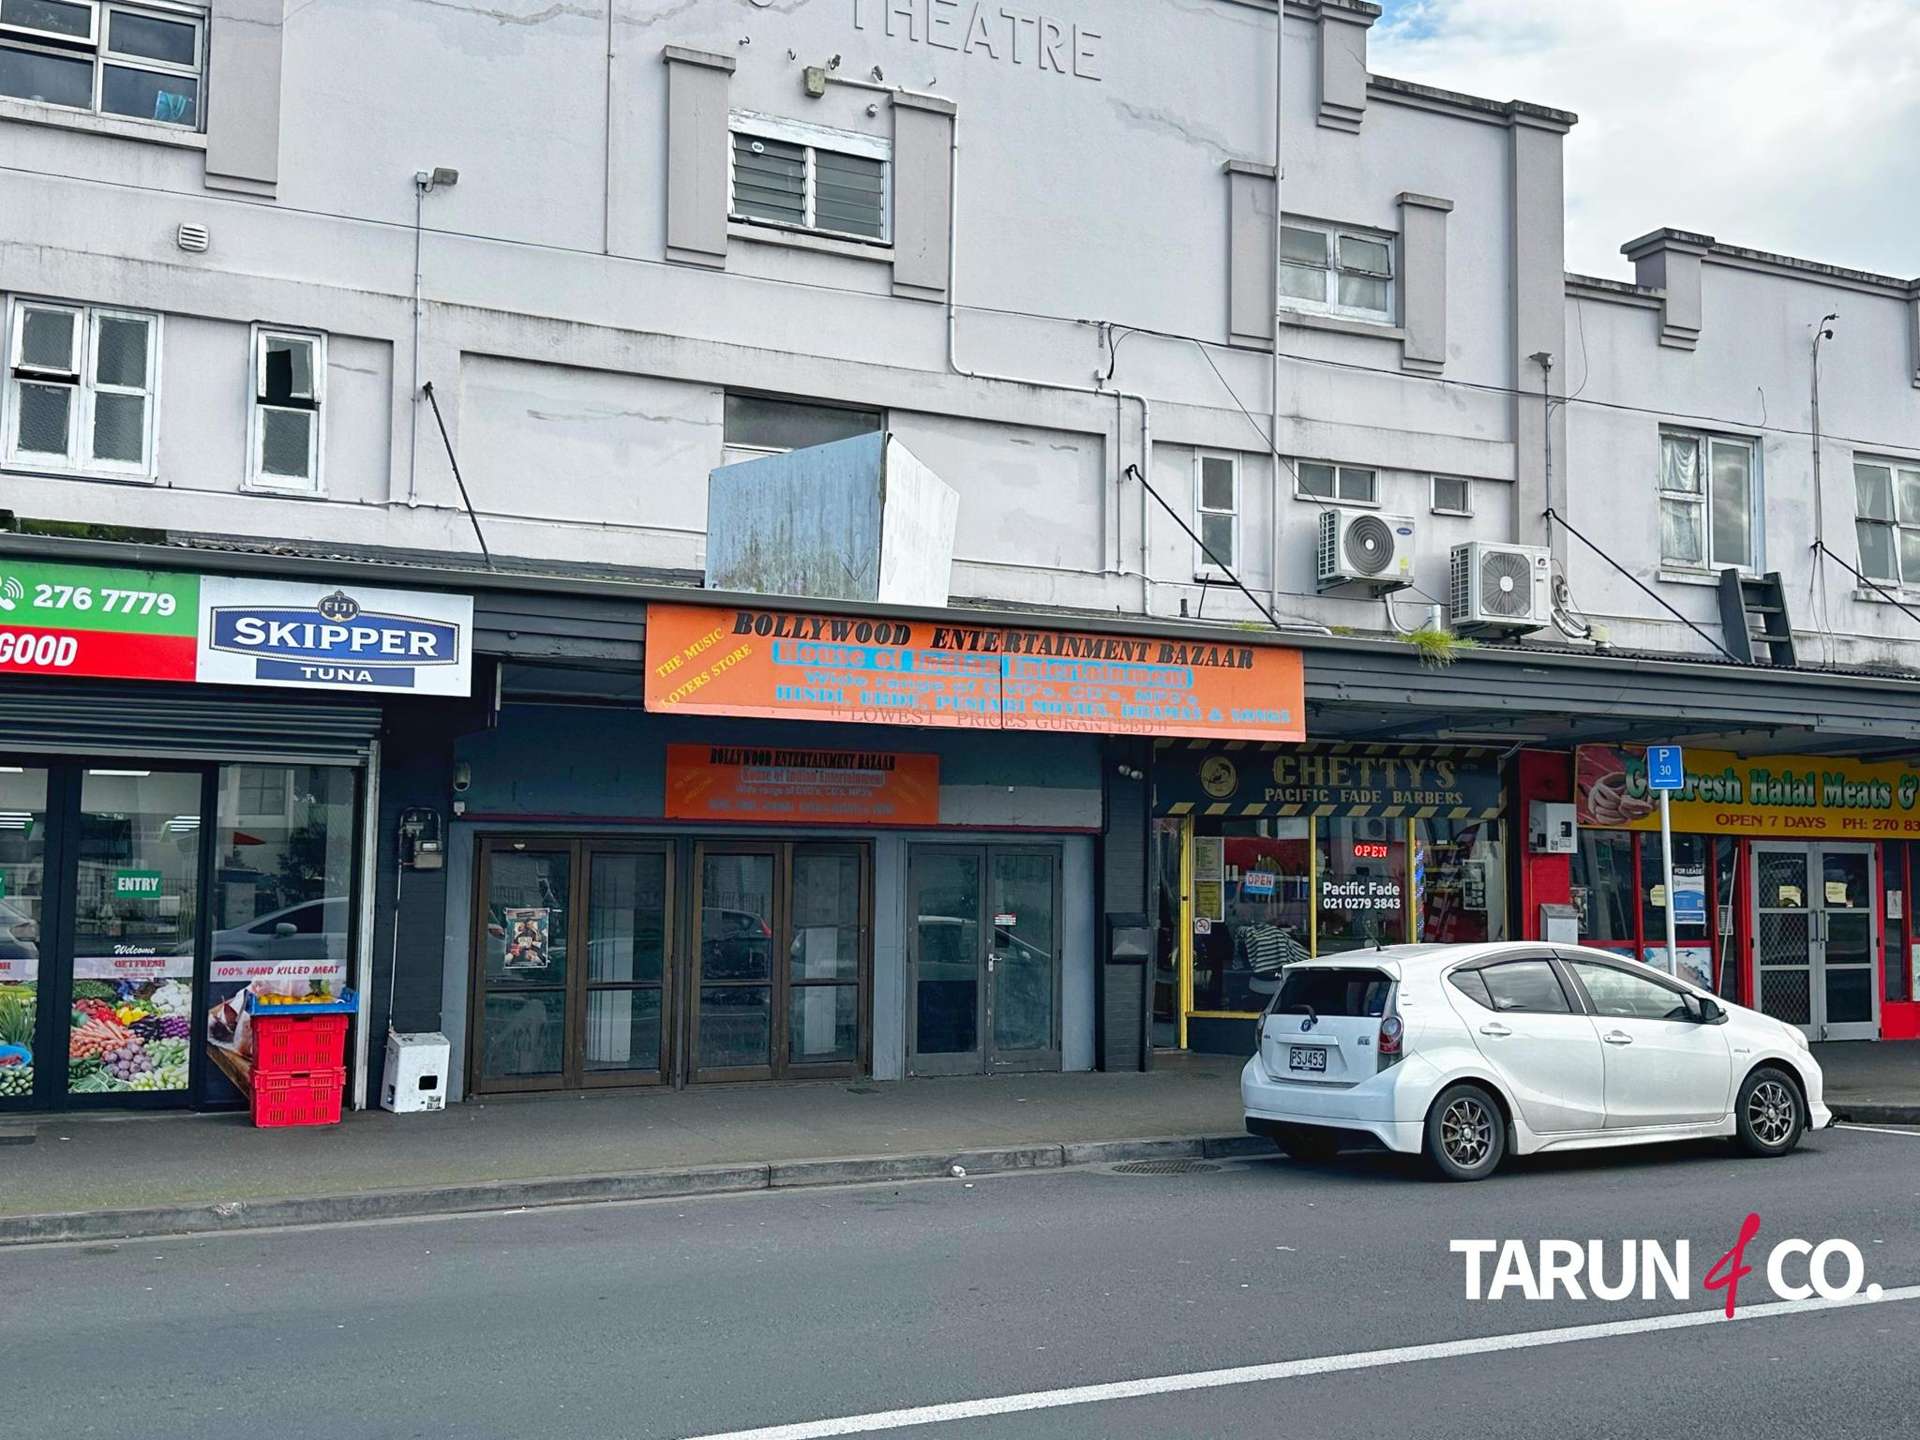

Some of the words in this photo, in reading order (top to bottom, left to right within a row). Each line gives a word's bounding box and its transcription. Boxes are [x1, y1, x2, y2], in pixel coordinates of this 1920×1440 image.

[33, 584, 93, 610] 276
[101, 588, 177, 616] 7779
[324, 602, 354, 613] FIJI
[233, 616, 439, 657] SKIPPER
[731, 612, 912, 646] BOLLYWOOD
[930, 627, 1152, 661] ENTERTAINMENT
[1157, 646, 1254, 669] BAZAAR
[0, 632, 78, 667] GOOD
[655, 655, 684, 678] THE
[683, 628, 725, 660] MUSIC
[777, 642, 866, 667] House
[301, 666, 374, 683] TUNA
[660, 671, 711, 709] LOVERS
[711, 643, 752, 676] STORE
[1659, 749, 1670, 762] P
[1273, 755, 1456, 789] CHETTY'S
[1659, 765, 1671, 776] 30
[1625, 760, 1743, 803] Gresh
[1749, 768, 1817, 806] Halal
[1823, 771, 1892, 808] Meats
[1898, 774, 1918, 810] &
[1264, 788, 1329, 802] PACIFIC
[1340, 789, 1382, 803] FADE
[1392, 791, 1464, 805] BARBERS
[1715, 813, 1762, 827] OPEN
[1768, 815, 1778, 827] 7
[1784, 816, 1826, 829] DAYS
[1842, 817, 1868, 829] PH:
[1872, 818, 1899, 831] 270
[1354, 845, 1388, 858] OPEN
[1674, 867, 1686, 875] FOR
[1686, 867, 1703, 875] LEASE
[118, 877, 158, 891] ENTRY
[1247, 874, 1272, 886] OPEN
[1323, 882, 1367, 896] Pacific
[1369, 882, 1400, 896] Fade
[1323, 898, 1342, 909] 021
[1345, 898, 1372, 909] 0279
[1374, 898, 1401, 909] 3843
[113, 944, 156, 955] Welcome
[217, 967, 243, 976] 100%
[246, 967, 274, 976] HAND
[277, 966, 310, 975] KILLED
[313, 965, 340, 974] MEAT
[1291, 1050, 1325, 1066] PSJ453
